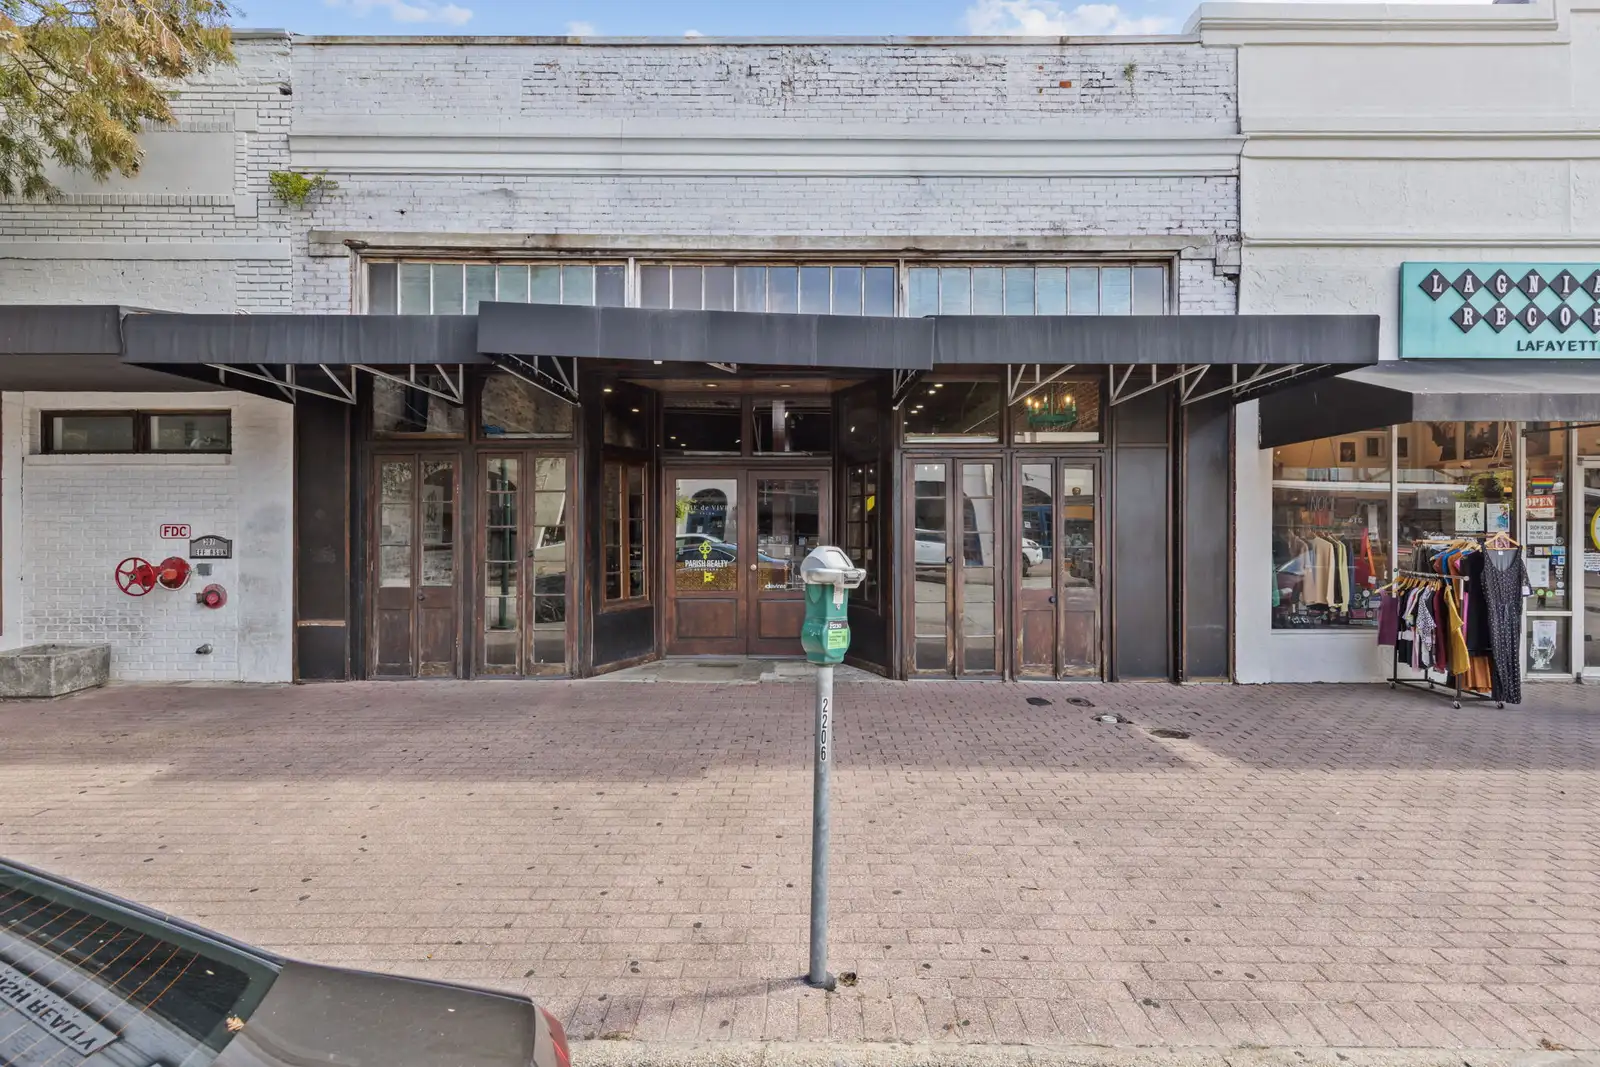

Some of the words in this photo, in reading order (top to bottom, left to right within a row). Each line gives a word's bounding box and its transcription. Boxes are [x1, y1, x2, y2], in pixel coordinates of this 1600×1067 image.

[1516, 340, 1600, 351] LAFAYETT
[163, 526, 187, 537] FDC
[684, 559, 706, 568] PARISH
[706, 559, 729, 568] REALTY
[820, 697, 829, 761] 2206
